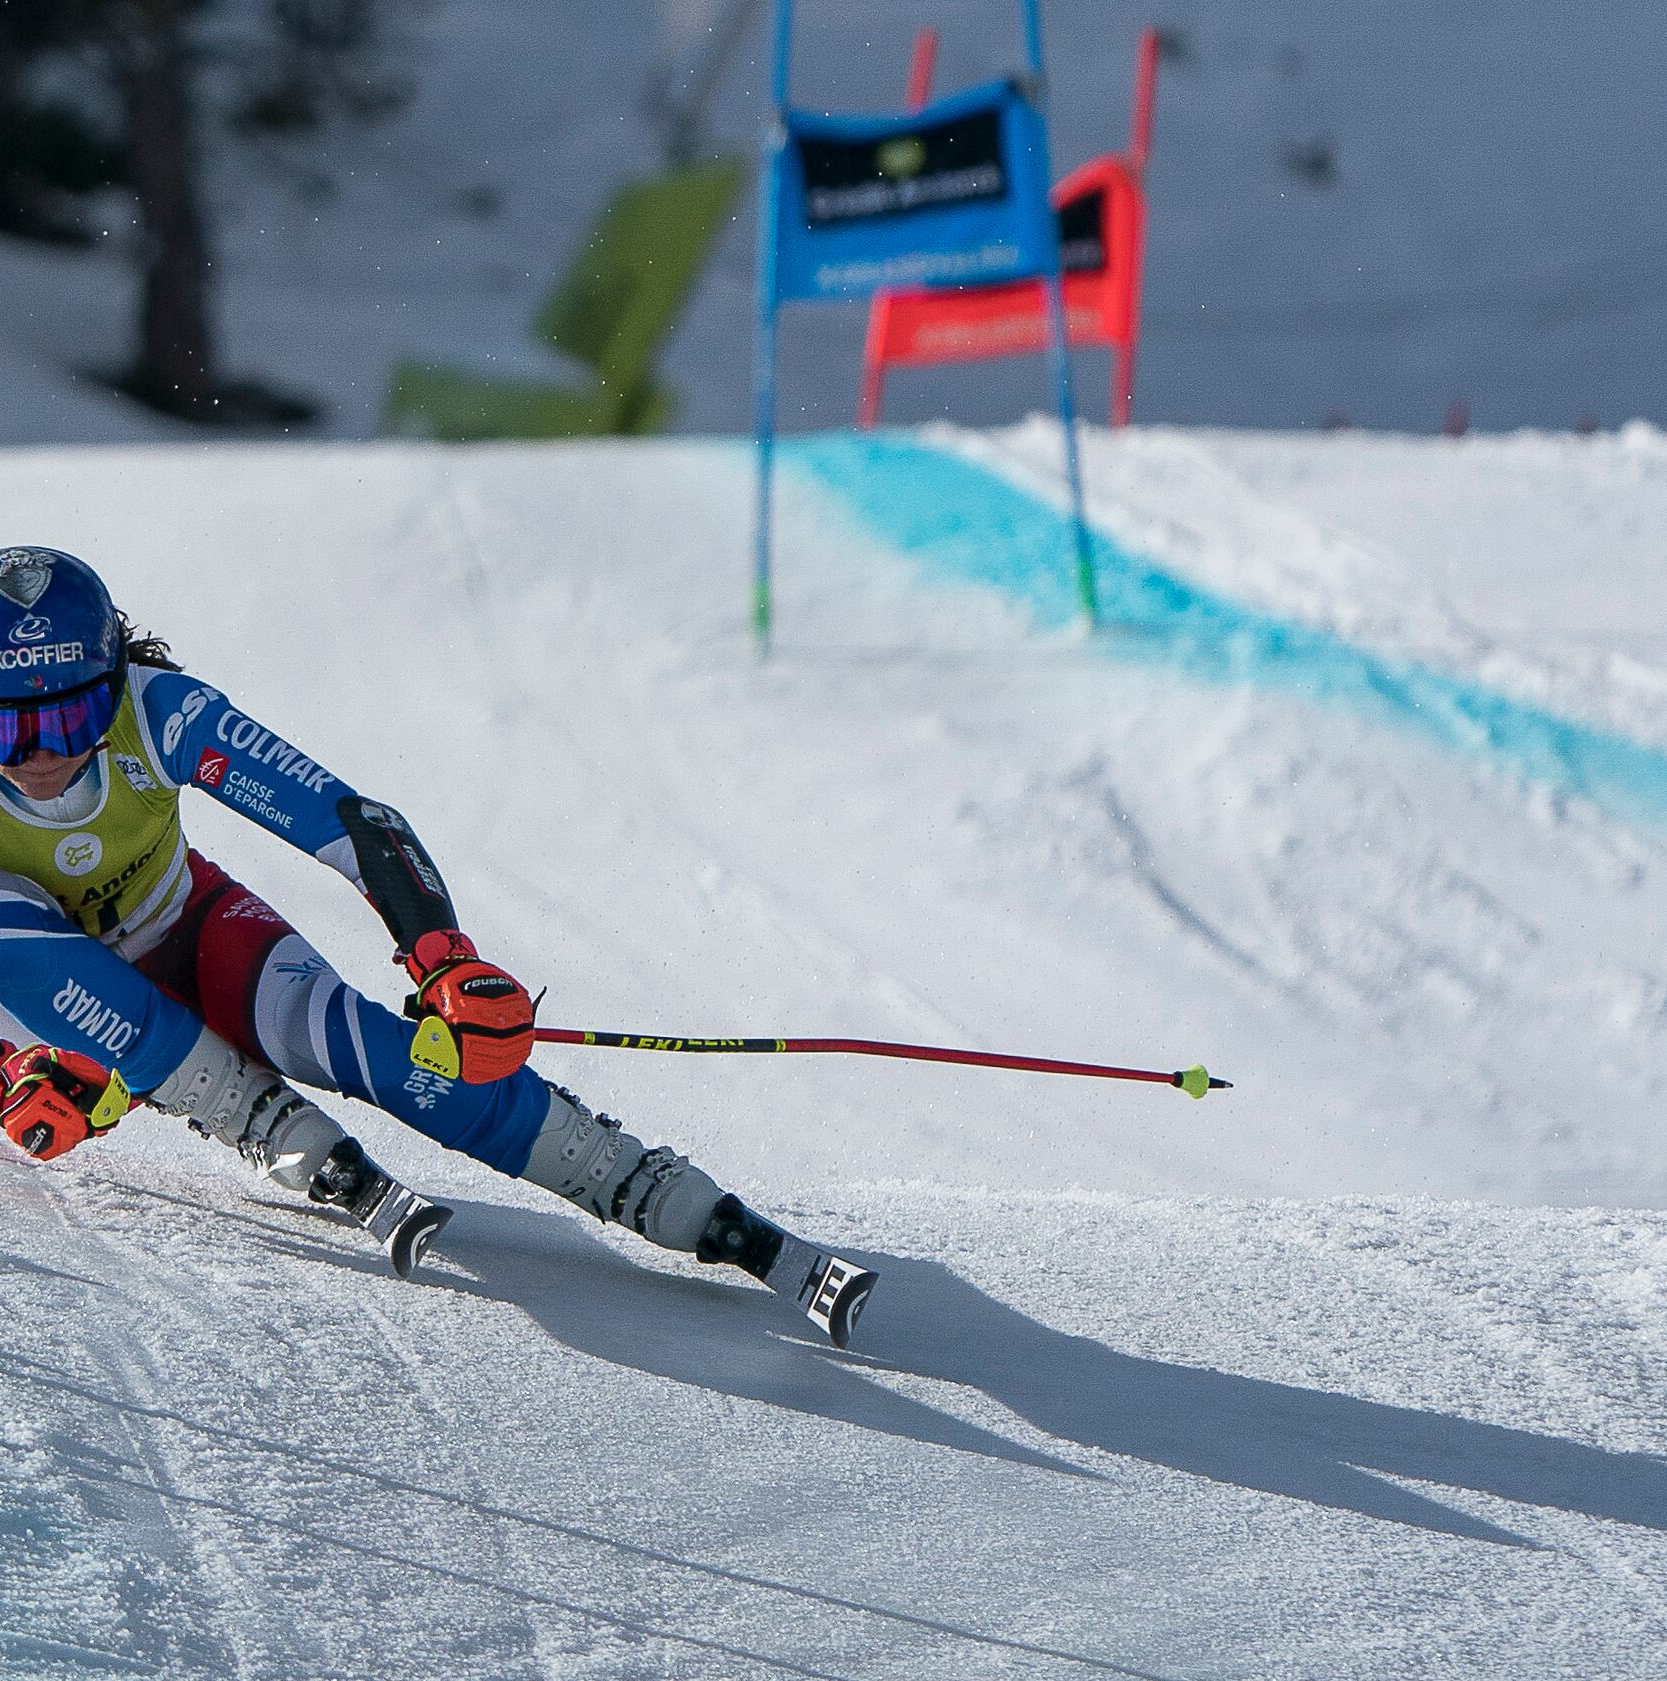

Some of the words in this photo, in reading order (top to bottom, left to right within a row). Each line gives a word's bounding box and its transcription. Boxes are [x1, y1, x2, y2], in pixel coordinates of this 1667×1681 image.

[216, 708, 337, 796] COLMAR
[222, 783, 295, 831] D'EPARGNE
[228, 770, 277, 804] CAISSE
[413, 1053, 449, 1073] LEKI
